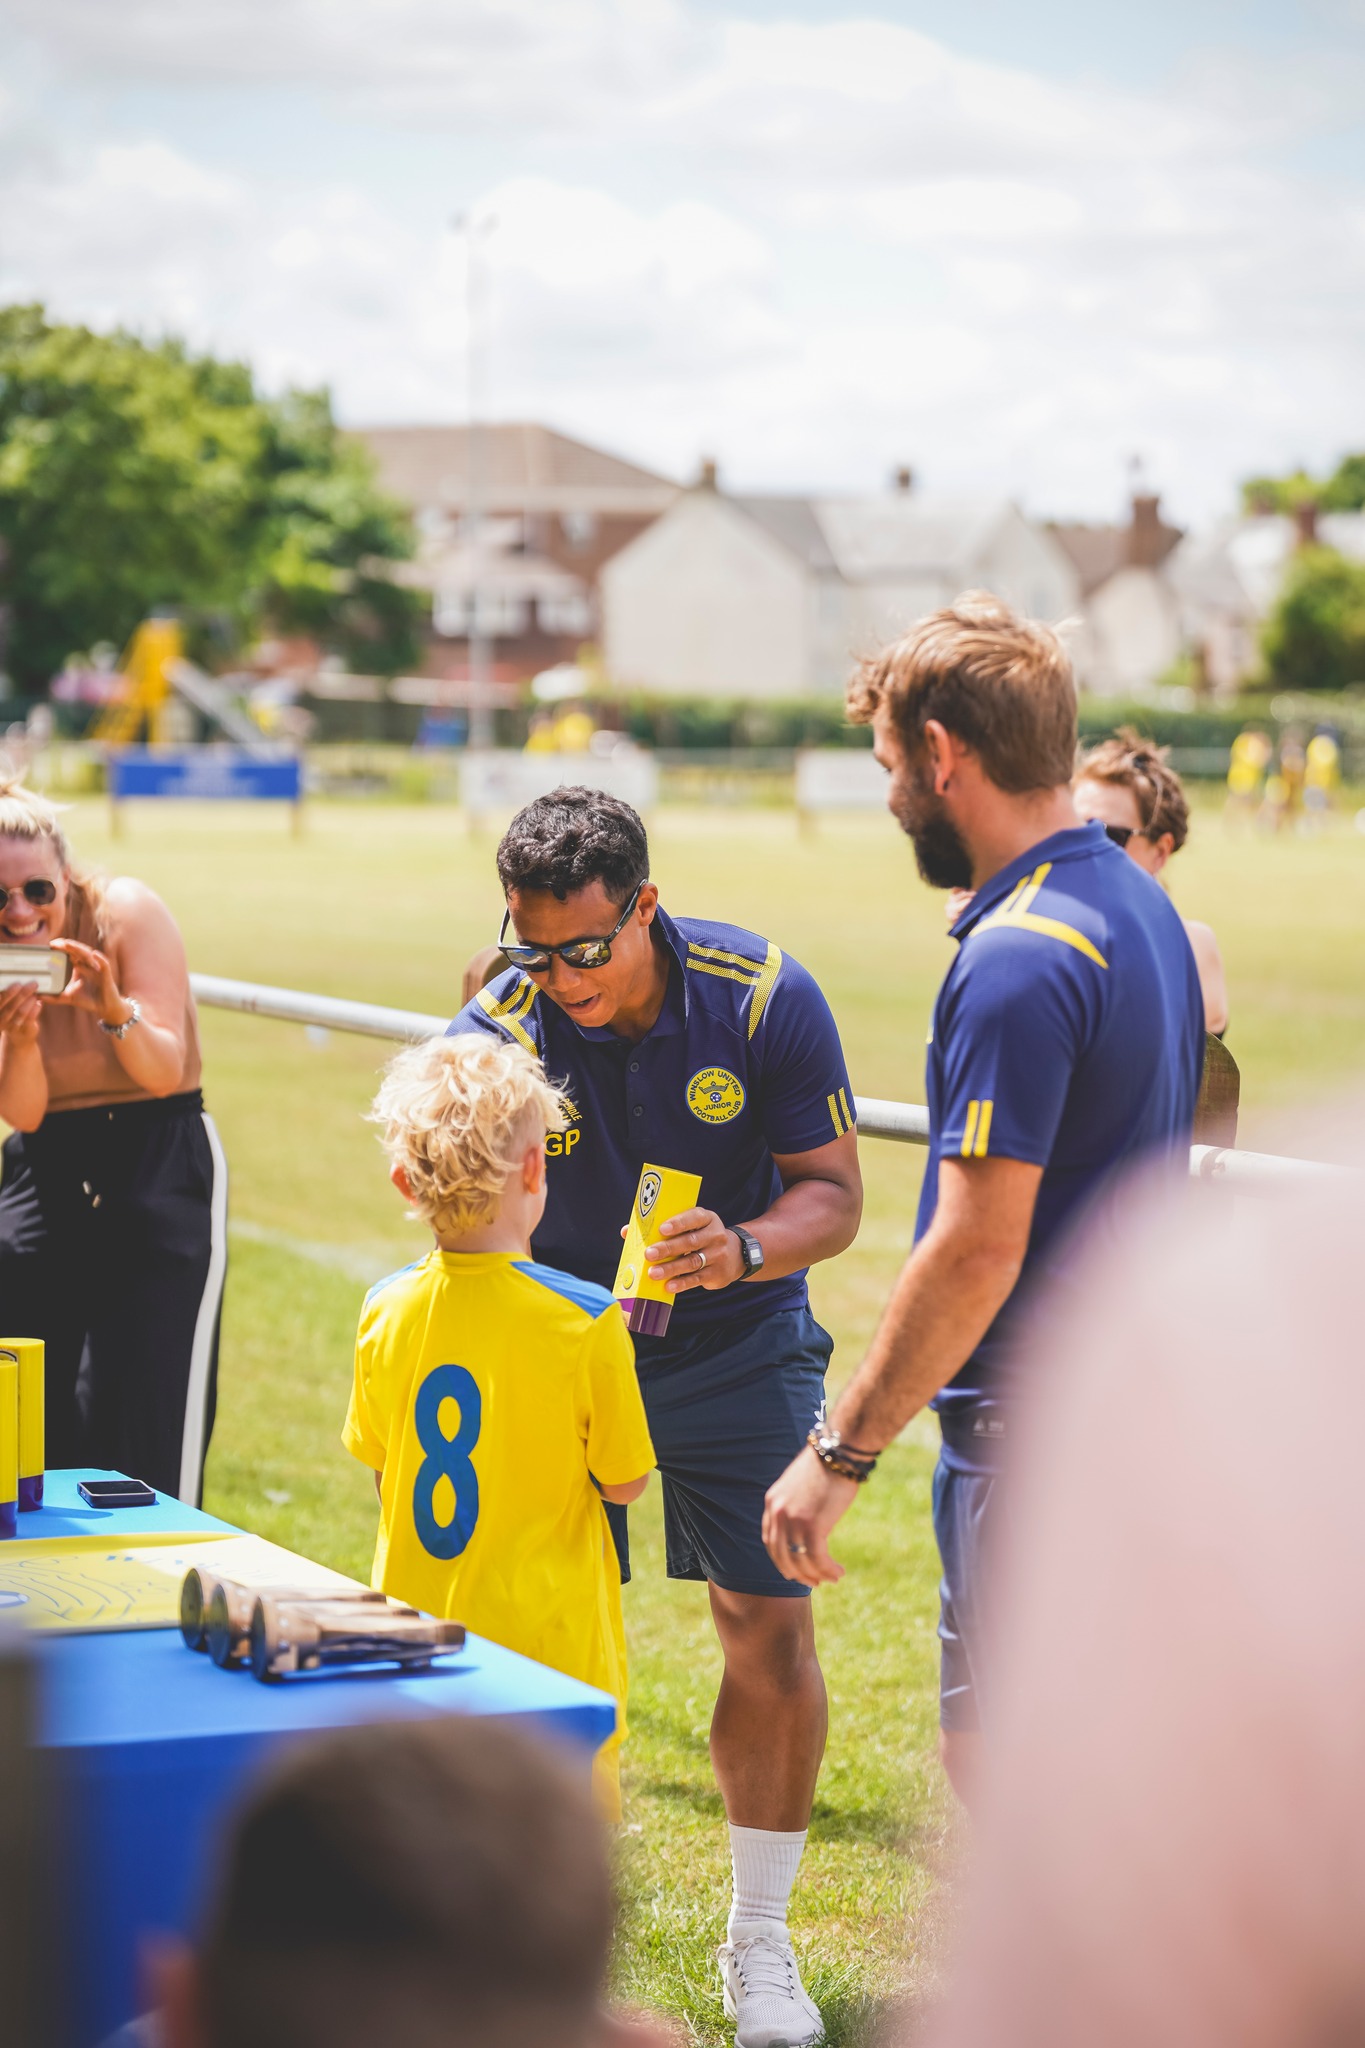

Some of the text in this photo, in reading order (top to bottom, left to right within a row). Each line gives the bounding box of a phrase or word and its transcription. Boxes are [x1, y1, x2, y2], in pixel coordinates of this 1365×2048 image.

[689, 1070, 741, 1101] WINSLOW UNITED
[693, 1100, 741, 1122] FOOTBALL CLUB
[703, 1101, 732, 1111] JUNIOR
[544, 1128, 580, 1157] GP
[412, 1364, 482, 1560] 8
